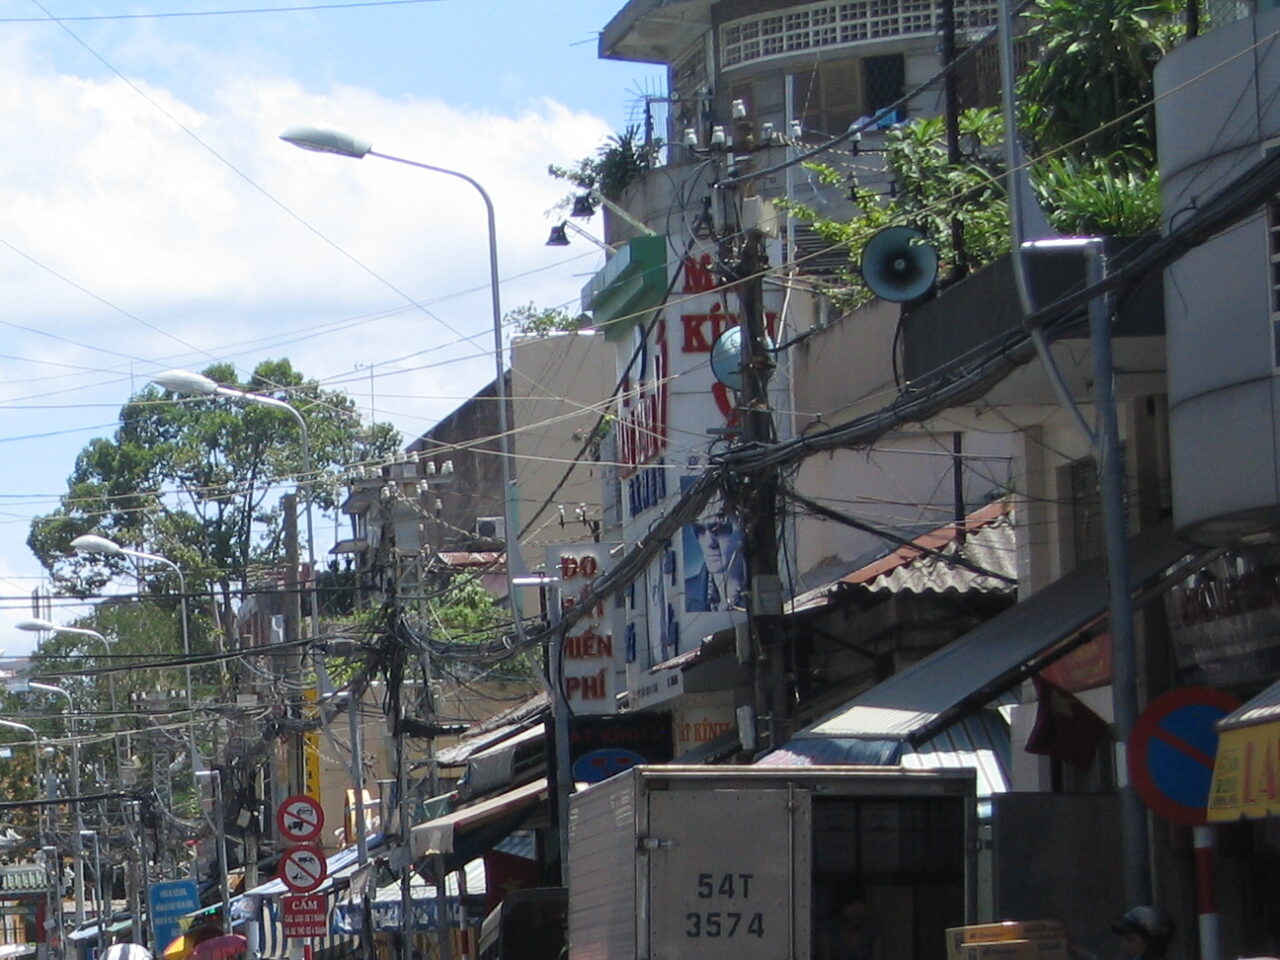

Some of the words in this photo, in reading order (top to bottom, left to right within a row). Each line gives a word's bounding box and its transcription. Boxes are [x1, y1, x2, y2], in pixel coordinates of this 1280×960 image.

[566, 667, 608, 700] PHÍ
[697, 873, 754, 899] 54T
[686, 912, 765, 938] 3574
